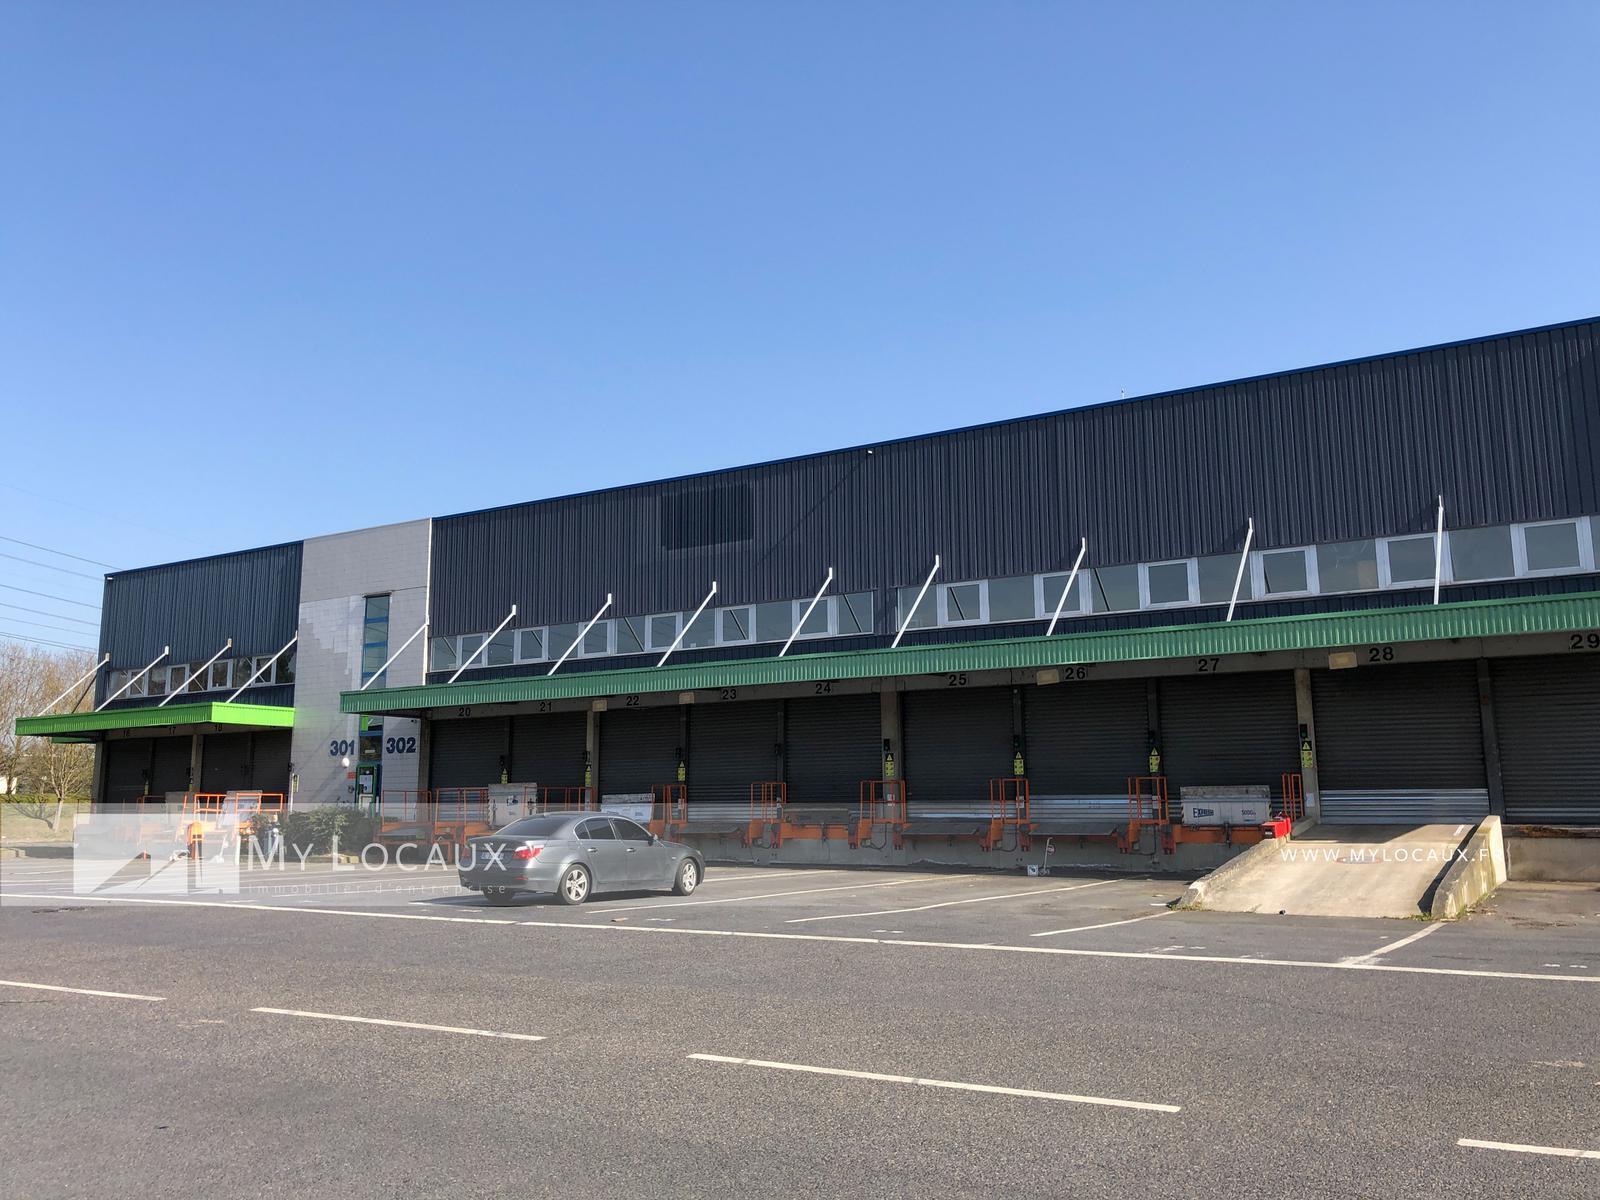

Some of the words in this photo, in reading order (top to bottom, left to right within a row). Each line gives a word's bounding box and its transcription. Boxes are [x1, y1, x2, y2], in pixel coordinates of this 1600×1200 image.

[1570, 633, 1600, 649] 29
[1369, 647, 1394, 662] 28
[1198, 658, 1219, 672] 27
[1065, 667, 1086, 680] 26
[948, 674, 967, 686] 25
[722, 689, 737, 699] 23
[815, 683, 832, 694] 24
[539, 702, 552, 712] 21
[626, 696, 640, 706] 22
[458, 707, 471, 717] 20
[329, 740, 355, 756] 301
[386, 736, 417, 754] 302
